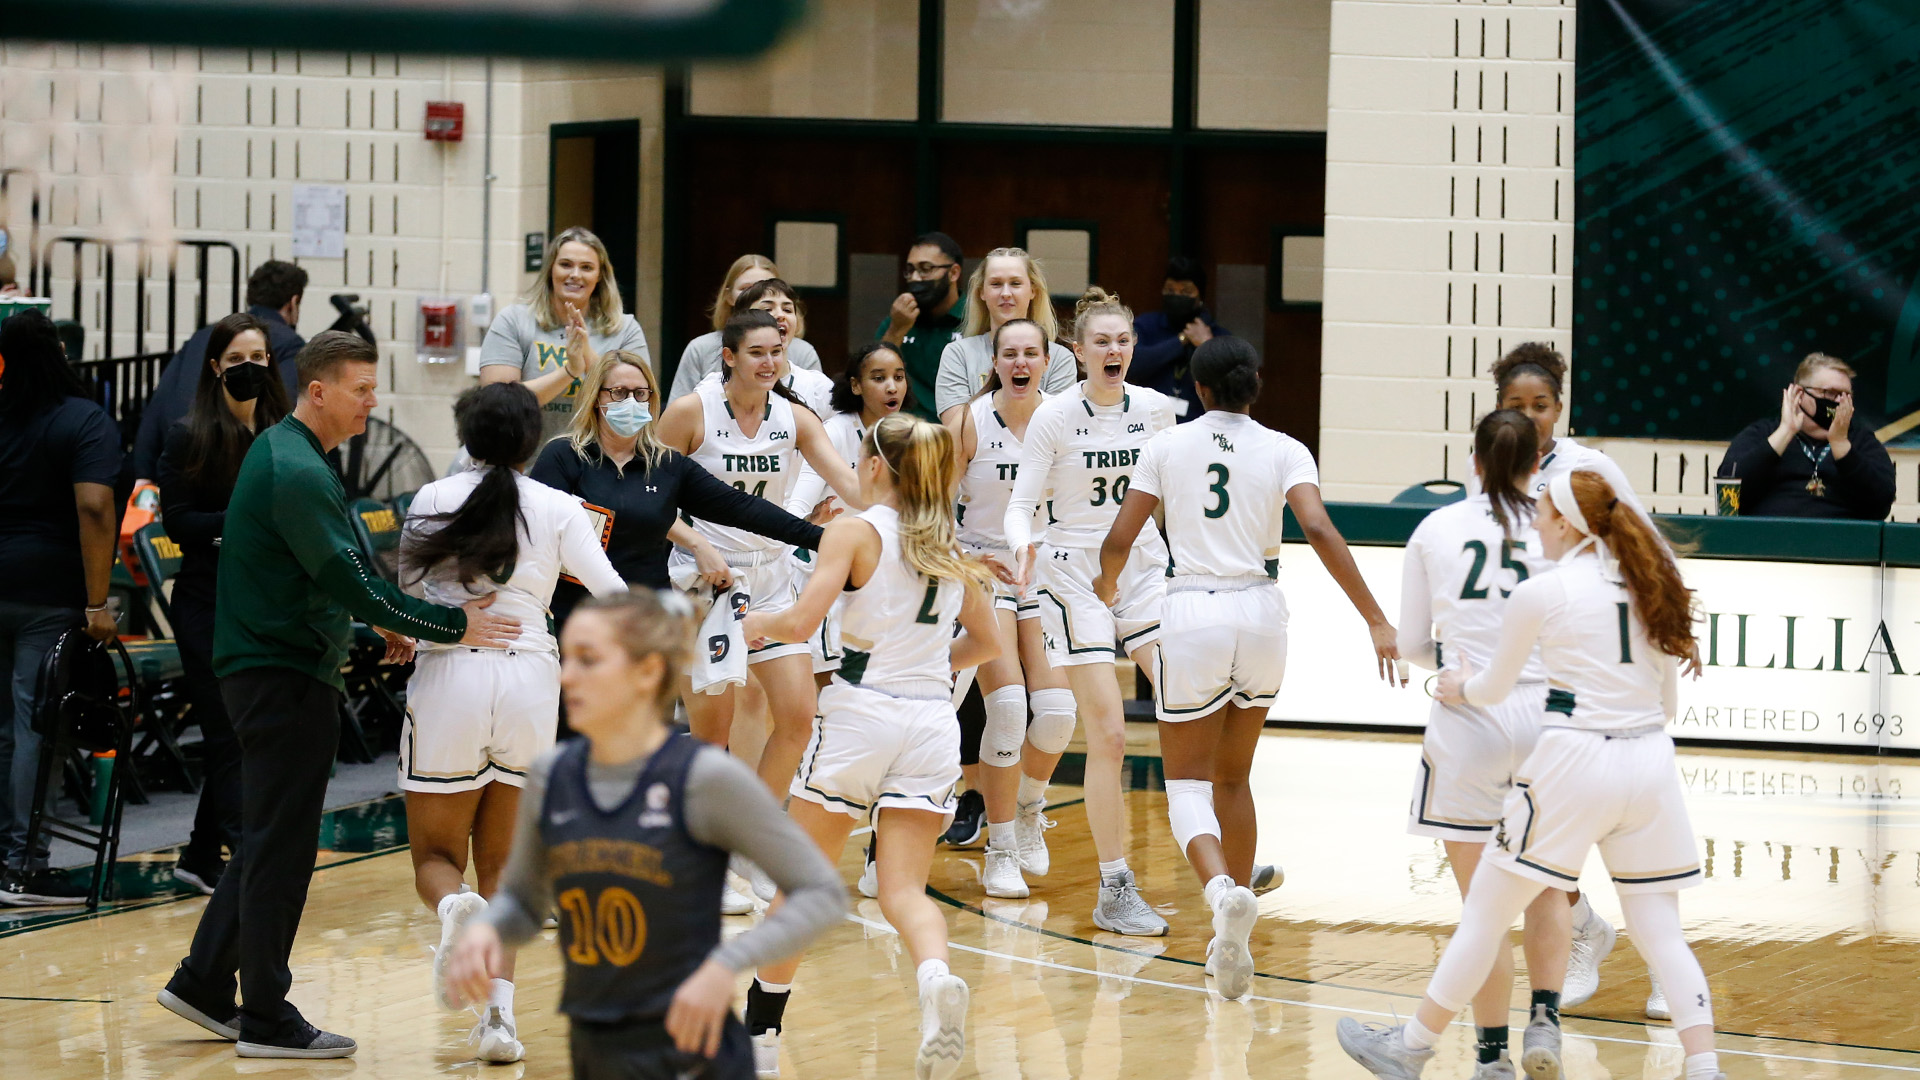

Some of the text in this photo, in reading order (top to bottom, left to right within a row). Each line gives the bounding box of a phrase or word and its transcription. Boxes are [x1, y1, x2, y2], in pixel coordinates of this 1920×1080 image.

[769, 430, 789, 441] CAA
[1127, 423, 1145, 434] CAA
[722, 454, 781, 473] TRIBE
[1089, 474, 1131, 507] 30
[1203, 463, 1231, 519] 3
[1459, 539, 1530, 599] 25
[1615, 602, 1634, 663] 1
[1701, 613, 1920, 676] ILLIA
[1674, 705, 1904, 737] ARTERED 1693
[559, 886, 648, 967] 10
